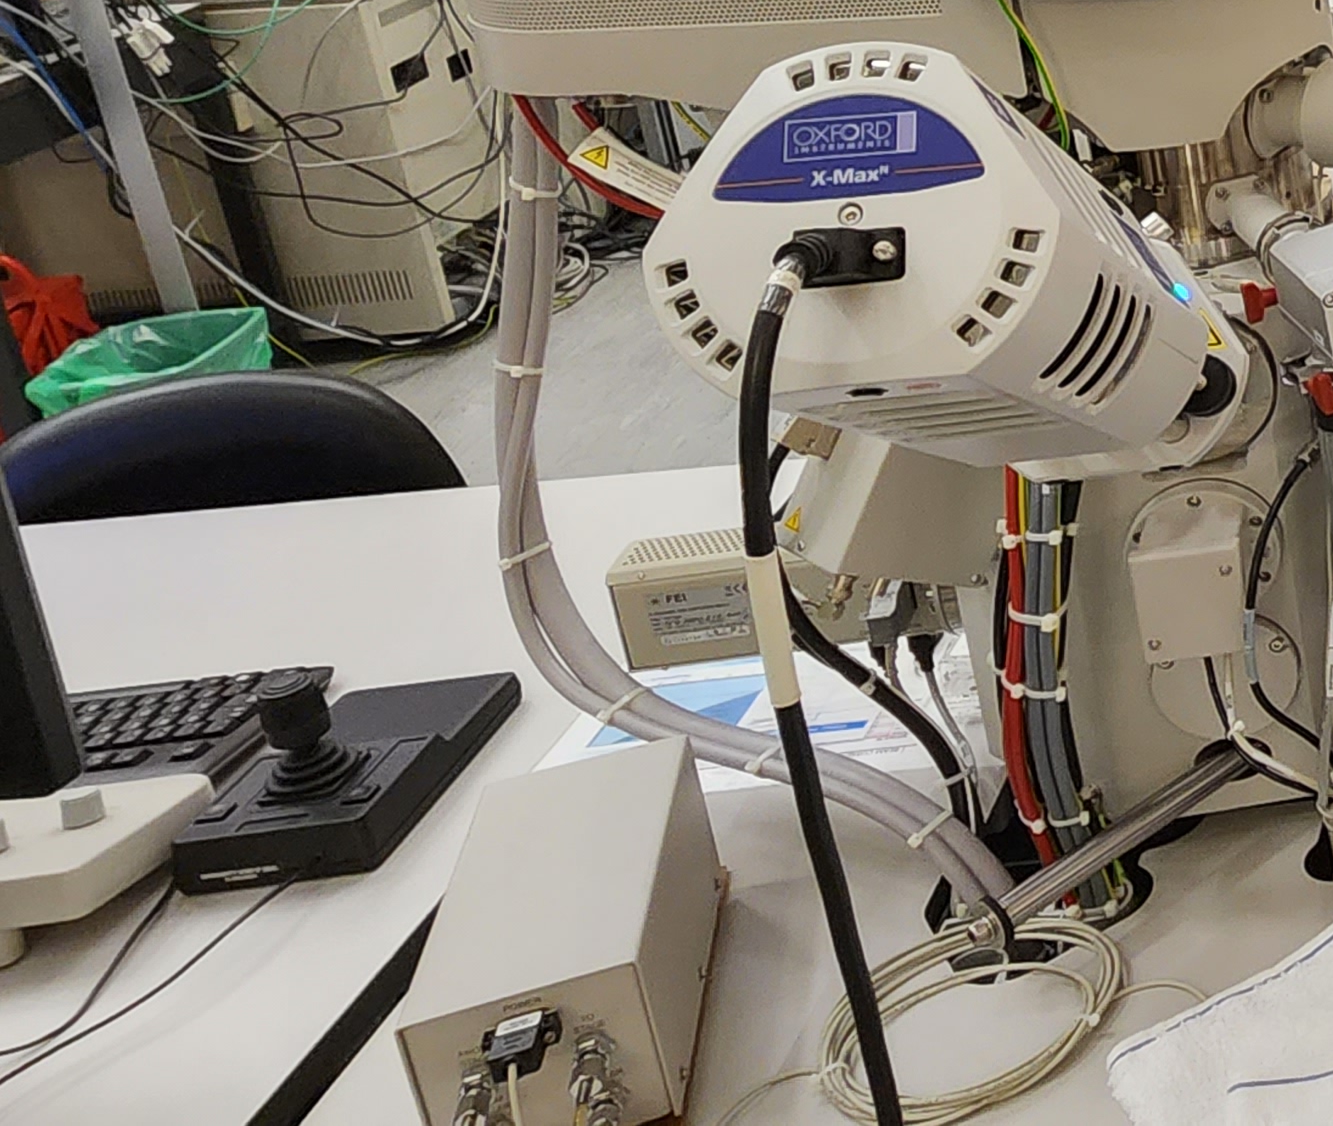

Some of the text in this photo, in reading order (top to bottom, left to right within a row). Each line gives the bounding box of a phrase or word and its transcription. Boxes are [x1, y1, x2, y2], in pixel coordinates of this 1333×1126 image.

[793, 121, 892, 146] OXFORD
[794, 139, 890, 155] INSTRUMENTS
[665, 593, 687, 603] FEI
